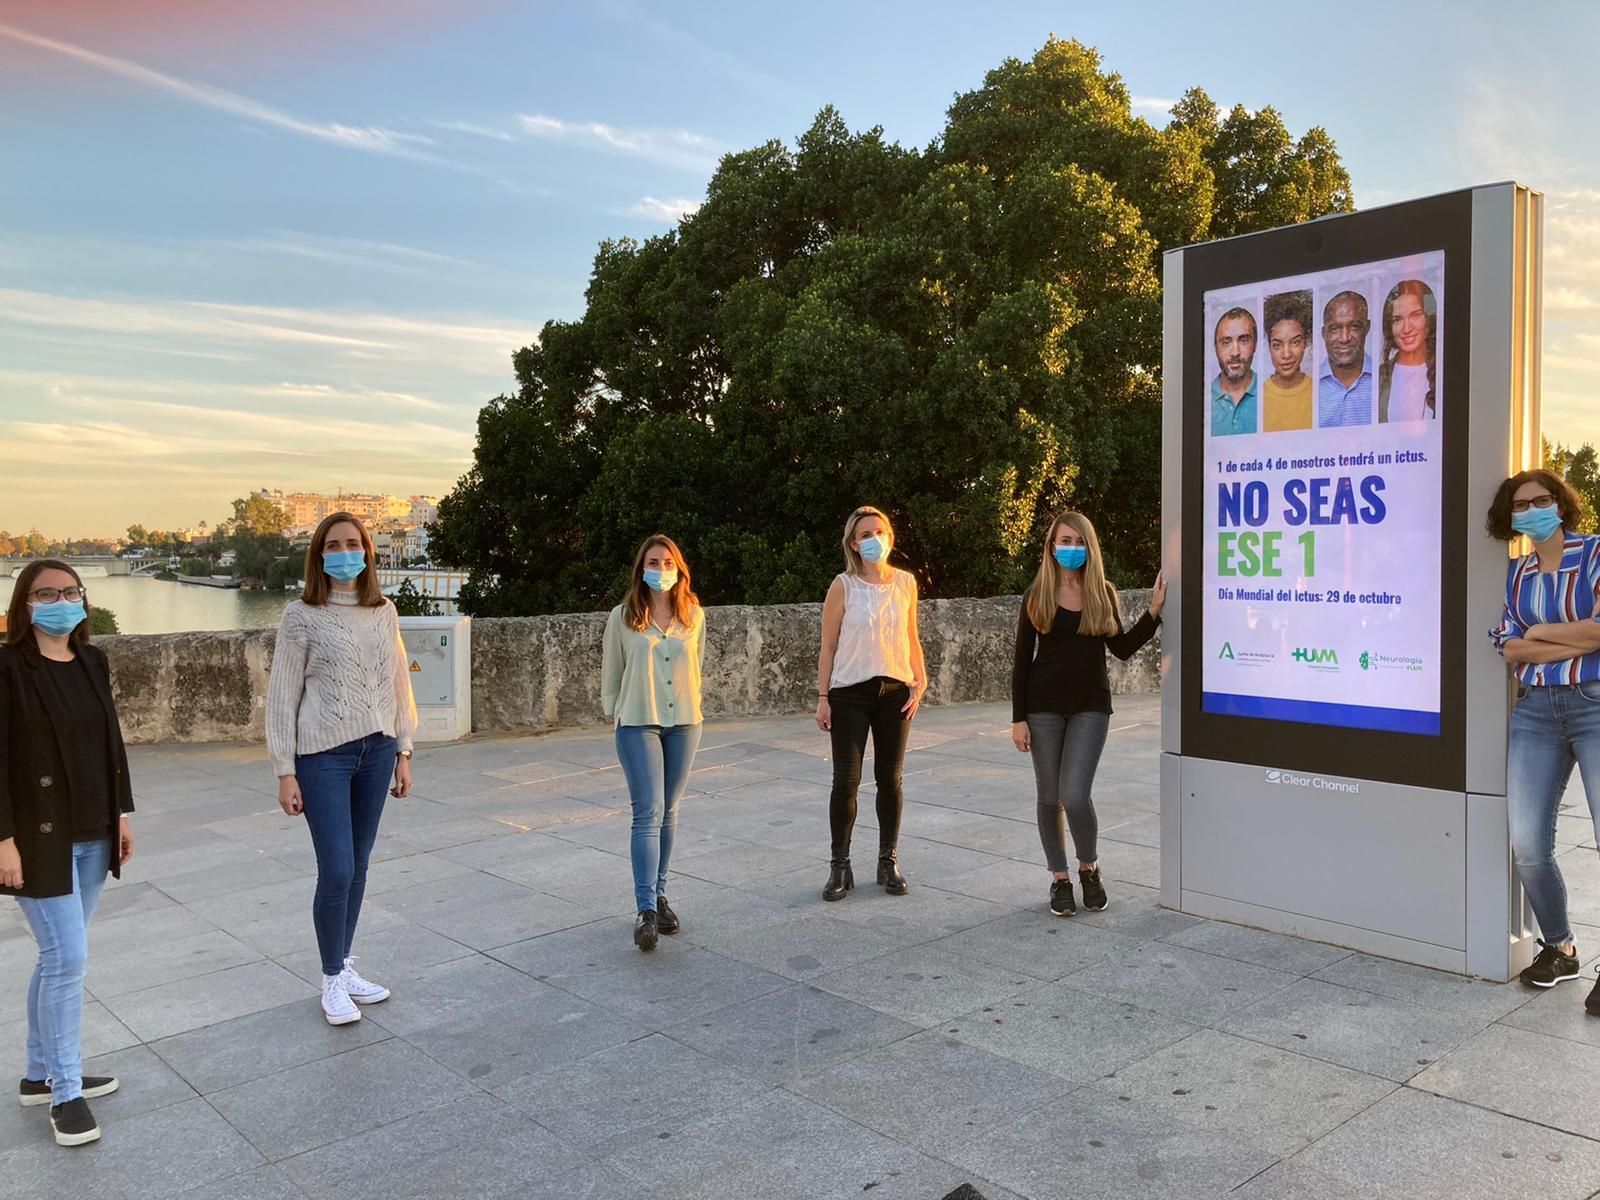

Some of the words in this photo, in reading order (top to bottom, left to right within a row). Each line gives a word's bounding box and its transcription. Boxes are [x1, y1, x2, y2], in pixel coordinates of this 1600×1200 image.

[1216, 461, 1222, 473] 1
[1226, 460, 1238, 472] de
[1240, 459, 1263, 472] cada
[1266, 458, 1272, 470] 4
[1275, 458, 1288, 470] de
[1290, 456, 1336, 469] nosotros
[1338, 451, 1374, 466] tendrá
[1378, 454, 1392, 464] un
[1395, 450, 1428, 464] ictus.
[1218, 480, 1269, 528] NO
[1283, 475, 1387, 526] SEAS
[1218, 530, 1282, 577] ESE
[1298, 530, 1316, 577] 1
[1218, 588, 1234, 600] Día
[1236, 588, 1274, 600] Mundial
[1276, 588, 1292, 602] del
[1326, 590, 1340, 603] 29
[1343, 590, 1356, 604] de
[1359, 592, 1402, 604] octubre
[1282, 773, 1312, 787] Clear
[1312, 778, 1360, 794] Channel
